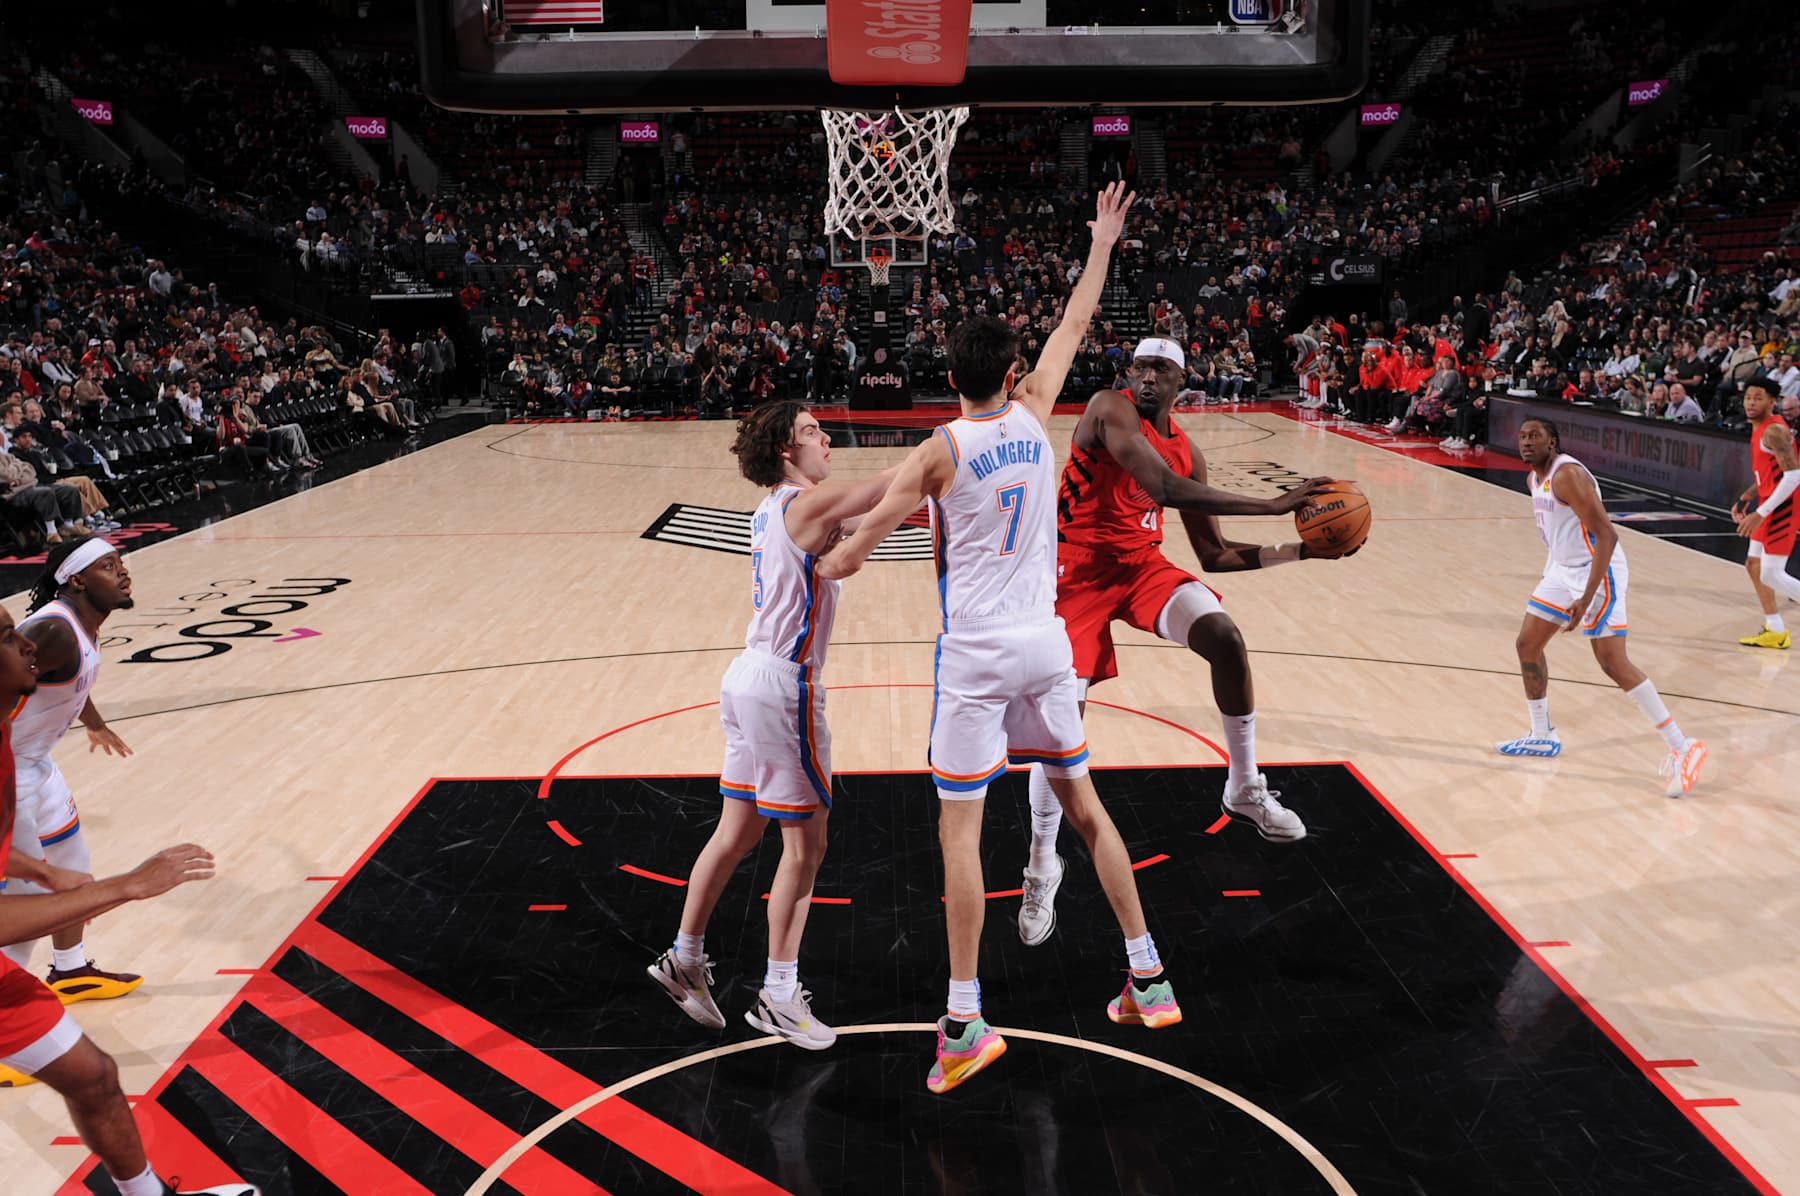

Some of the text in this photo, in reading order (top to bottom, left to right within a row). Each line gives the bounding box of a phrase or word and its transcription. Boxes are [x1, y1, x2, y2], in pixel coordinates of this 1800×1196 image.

[862, 0, 942, 41] Stat
[1237, 0, 1263, 15] NBA
[348, 119, 385, 134] moda
[623, 124, 657, 138] moda
[1094, 118, 1129, 132] moda
[1344, 264, 1375, 274] CELSIUS
[860, 372, 902, 389] ripcity
[968, 441, 1042, 481] HOLMGREN
[1602, 428, 1623, 453] GET
[1624, 429, 1664, 464] YOURS
[1664, 437, 1706, 473] TODAY
[996, 481, 1028, 556] 7
[752, 548, 764, 612] 3
[117, 577, 353, 664] moda
